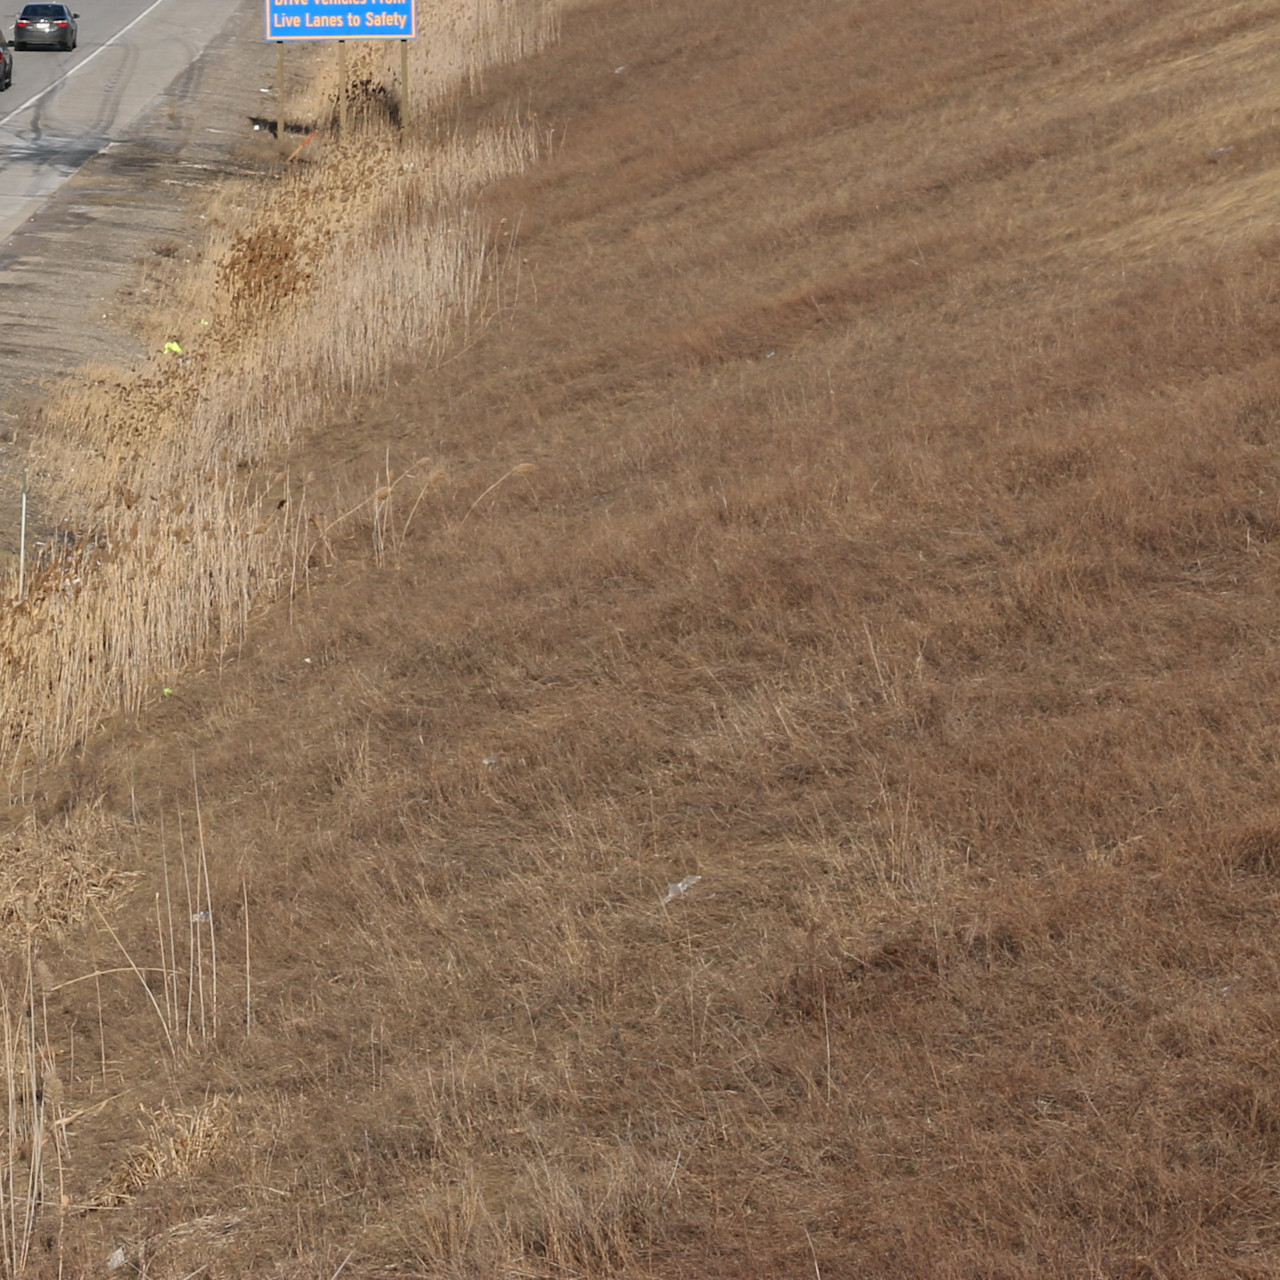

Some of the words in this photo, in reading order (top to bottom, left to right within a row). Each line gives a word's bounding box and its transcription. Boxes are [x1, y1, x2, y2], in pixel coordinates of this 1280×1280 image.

[274, 13, 301, 27] Live
[305, 13, 343, 27] Lanes
[347, 12, 361, 26] to
[365, 11, 408, 29] Safety
